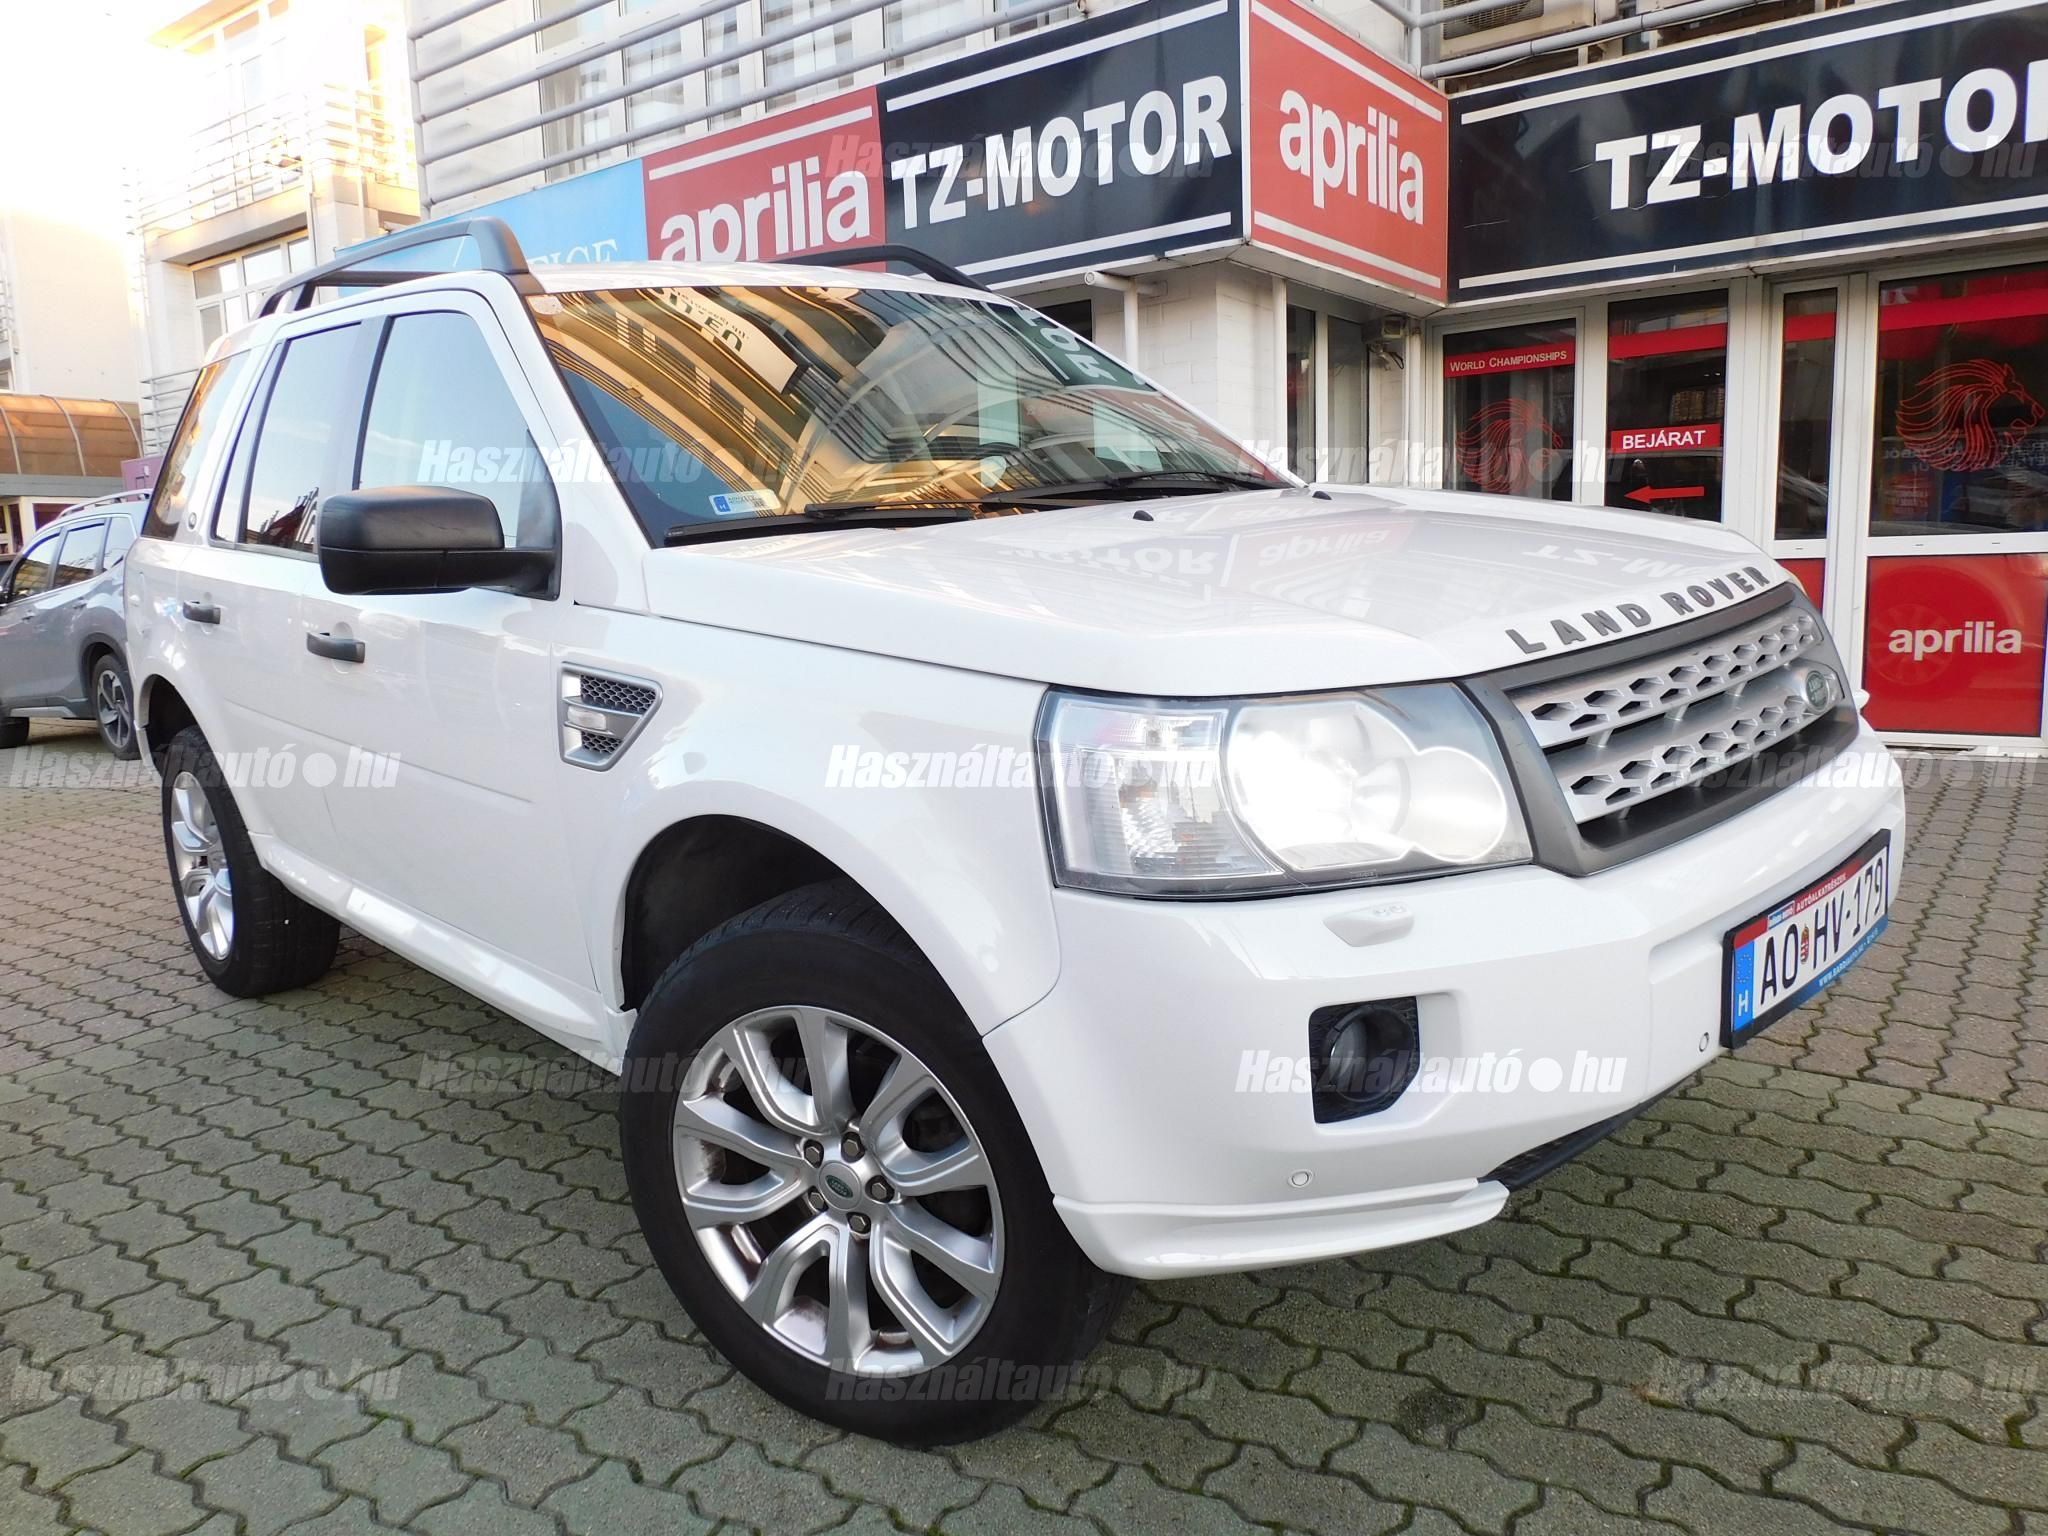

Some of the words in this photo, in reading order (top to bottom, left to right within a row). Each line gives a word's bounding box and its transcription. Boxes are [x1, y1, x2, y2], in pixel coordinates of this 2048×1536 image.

[891, 75, 1232, 229] TZ-MOTOR
[1279, 89, 1425, 225] aprilia
[660, 156, 871, 263] aprilia
[1450, 359, 1485, 372] WORLD
[1488, 350, 1568, 368] CHAMPIONSHIPS
[1622, 429, 1706, 449] BEJÁRAT
[1505, 603, 1652, 654] LAND
[1660, 566, 1770, 616] ROVER
[1888, 621, 2022, 661] aprilia
[1760, 923, 1799, 1006] AO
[1812, 857, 1883, 970] HV-179
[1737, 989, 1749, 1017] H
